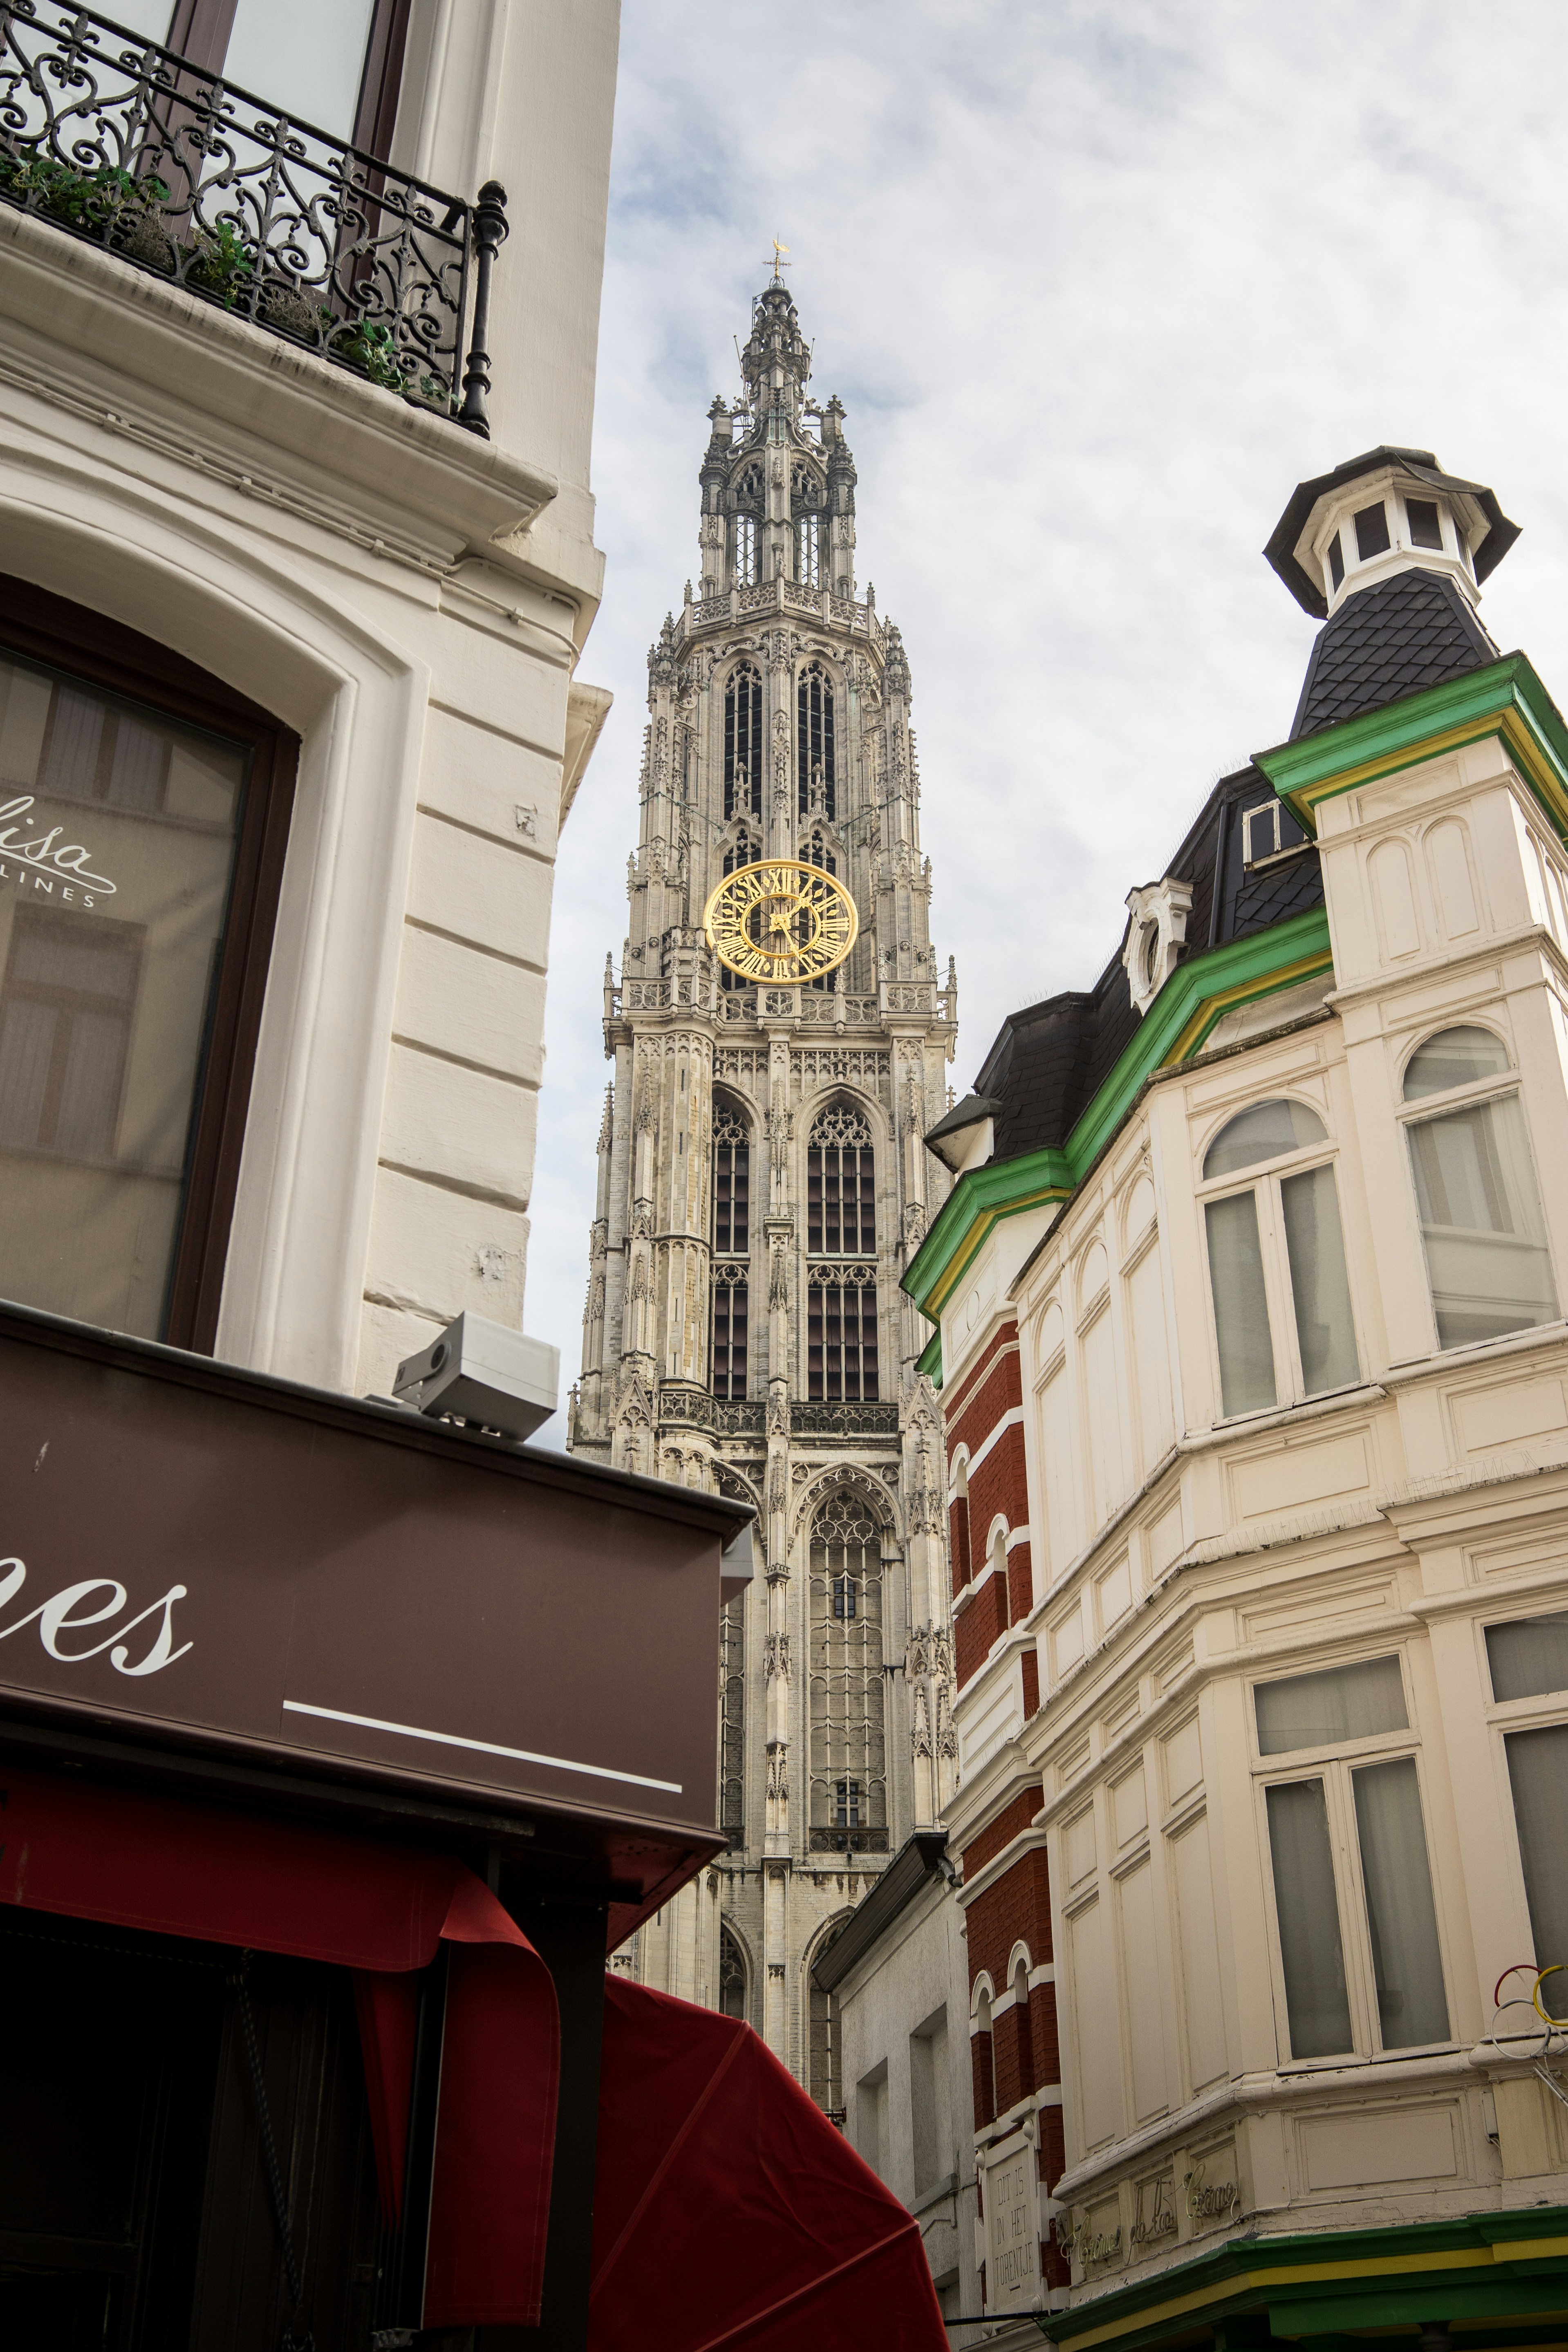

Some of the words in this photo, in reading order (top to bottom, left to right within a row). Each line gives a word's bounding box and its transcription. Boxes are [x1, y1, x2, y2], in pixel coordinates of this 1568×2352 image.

[0, 864, 94, 907] LINES
[997, 2173, 1010, 2206] DIT
[1015, 2166, 1024, 2196] IS
[997, 2216, 1005, 2245] IN
[1011, 2205, 1027, 2238] HET
[995, 2242, 1034, 2287] TORENTJE
